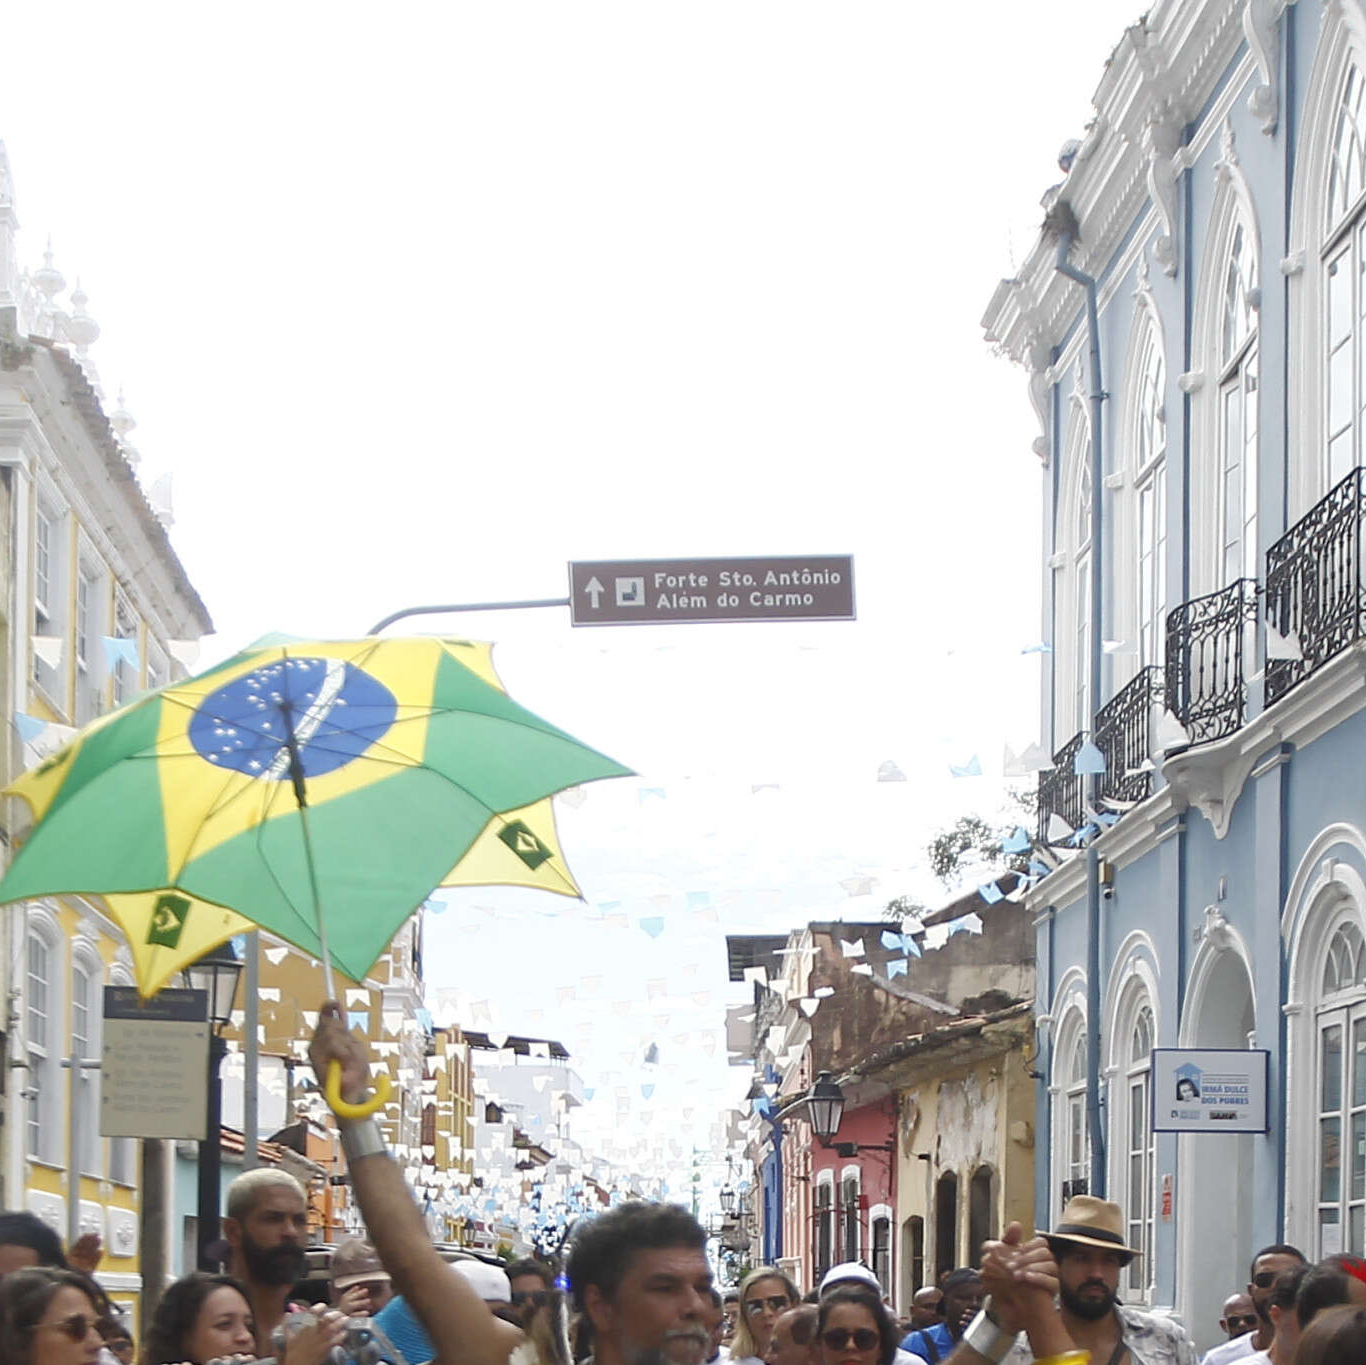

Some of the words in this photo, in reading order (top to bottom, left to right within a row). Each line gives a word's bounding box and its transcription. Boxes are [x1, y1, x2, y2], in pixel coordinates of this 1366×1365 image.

[654, 572, 709, 588] Forte
[719, 571, 757, 587] Sto.
[763, 568, 841, 586] Antônio
[656, 591, 707, 609] Além
[717, 592, 739, 607] do
[749, 592, 814, 606] Carmo
